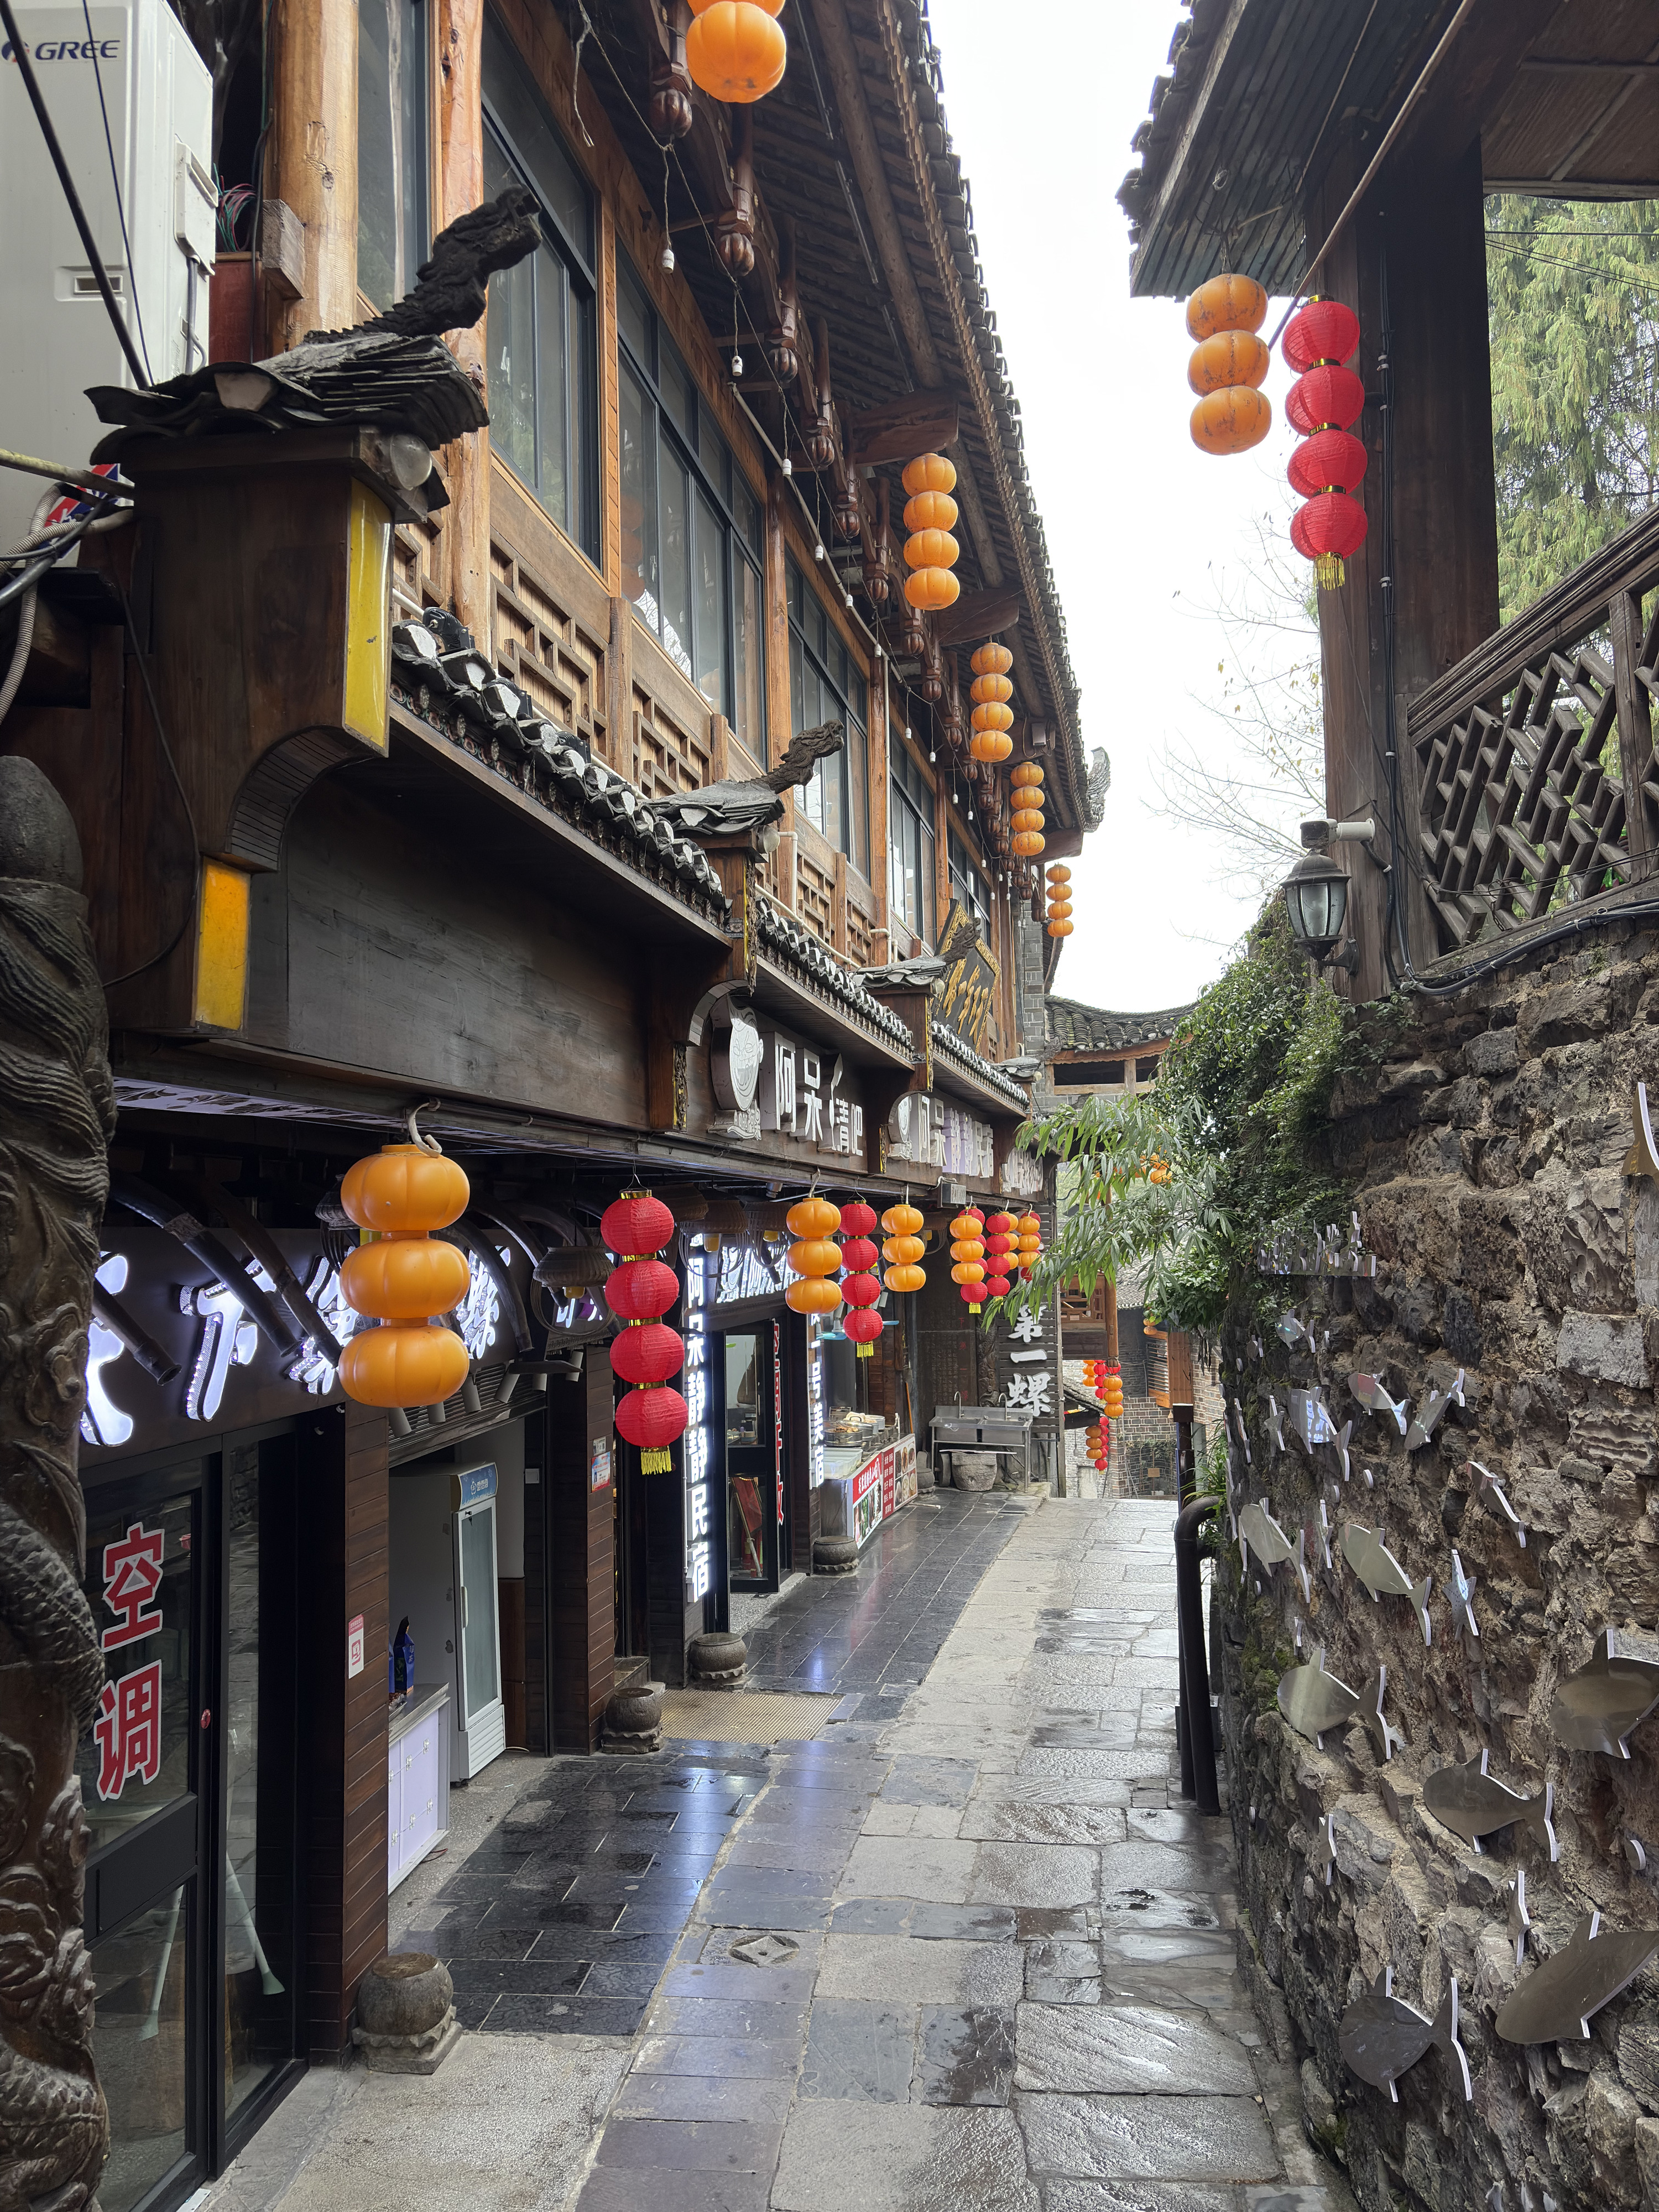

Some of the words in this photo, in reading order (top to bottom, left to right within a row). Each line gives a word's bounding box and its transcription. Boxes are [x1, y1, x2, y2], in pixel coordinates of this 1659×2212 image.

[35, 40, 121, 60] GREE
[775, 1032, 863, 1156] 阿呆清吧
[687, 1258, 709, 1603] 阿呆静静民宿
[94, 1522, 165, 1801] 空调
